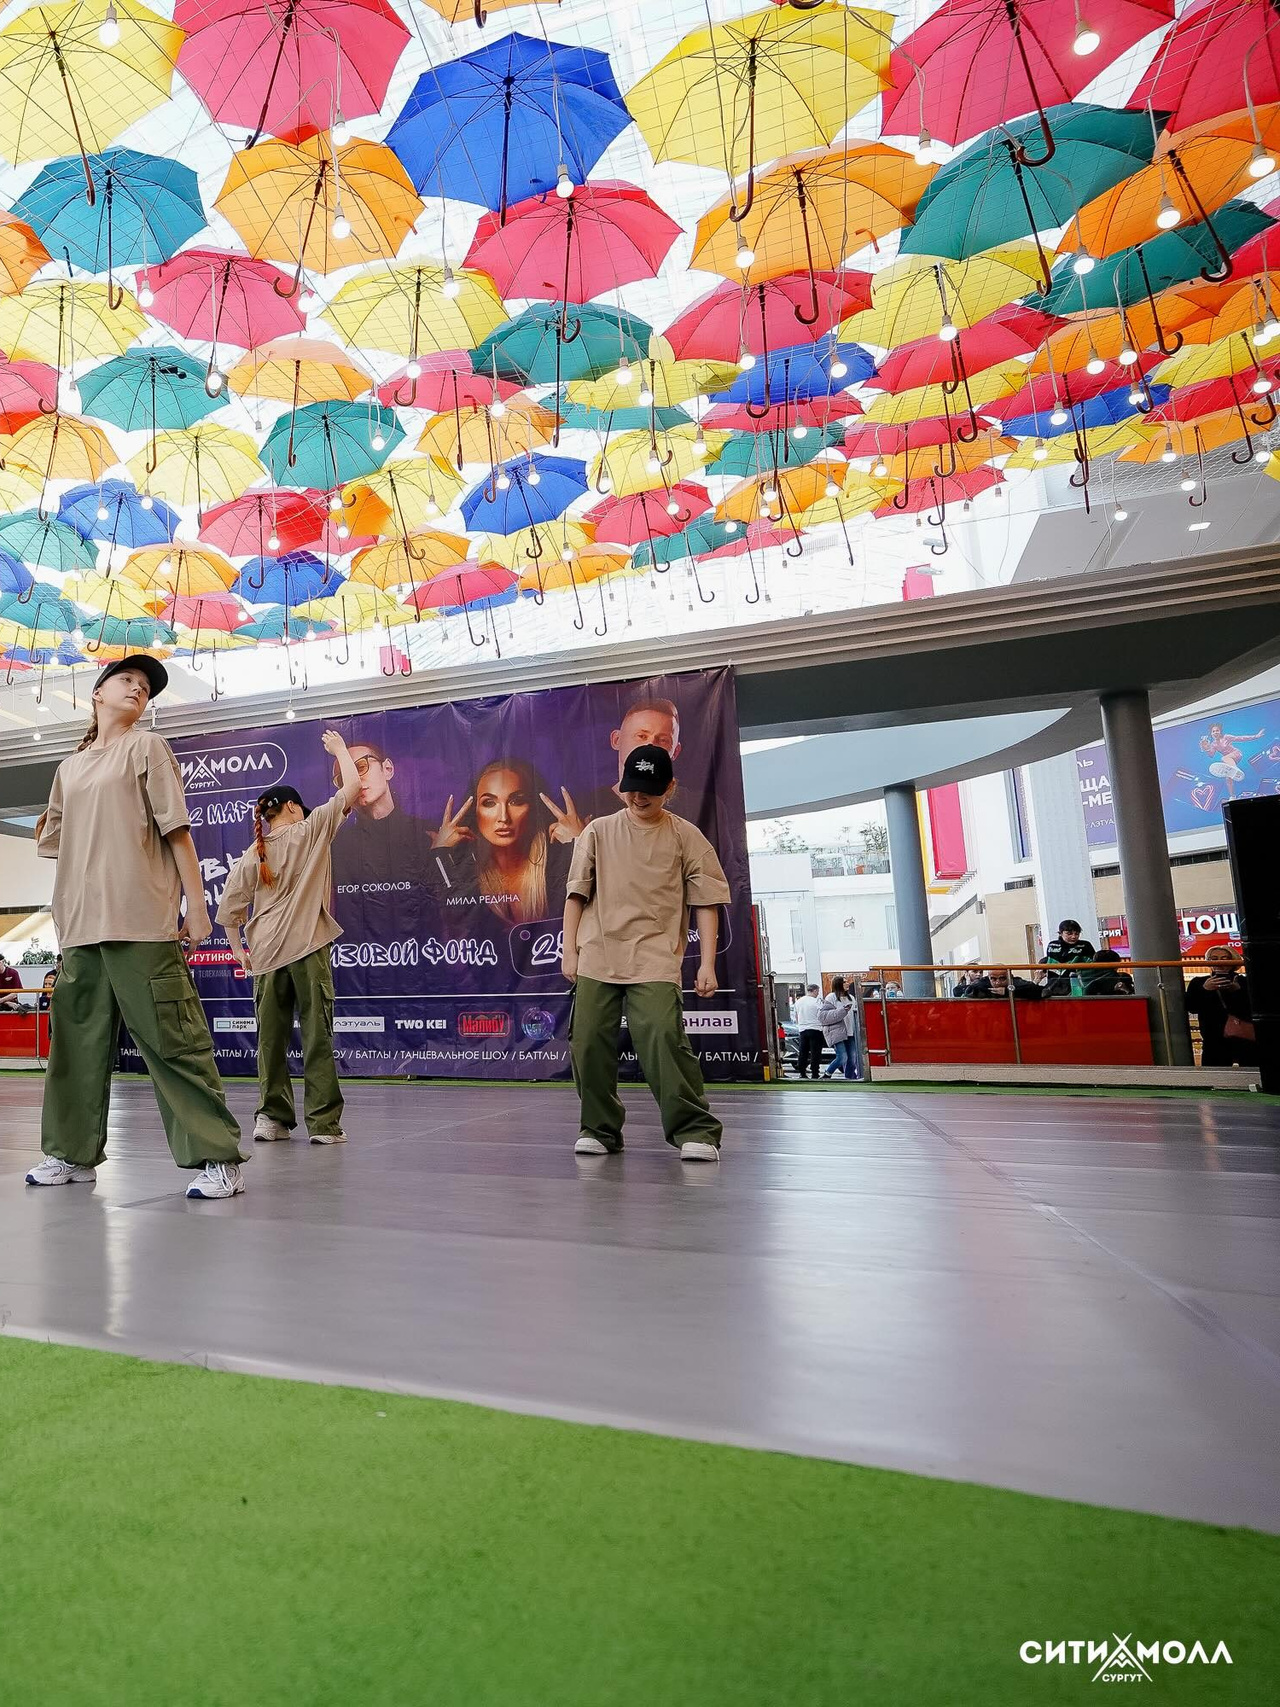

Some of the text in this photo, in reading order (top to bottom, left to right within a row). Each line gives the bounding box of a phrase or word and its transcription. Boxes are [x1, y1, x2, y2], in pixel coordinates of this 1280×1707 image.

[190, 780, 215, 789] СУРГУТ
[337, 881, 411, 894] ЕГОР СОКОЛОВ
[446, 894, 520, 906] МИЛА РЕДИНА
[331, 937, 498, 968] ИЗОВОЙ ФОНД
[395, 1019, 447, 1029] TWO KEI
[355, 1050, 391, 1059] БАТТЛЫ
[401, 1050, 479, 1061] ТАНЦЕВАЛЬНОЕ
[482, 1050, 507, 1060] ШОУ
[519, 1051, 559, 1061] БАТТЛЫ
[705, 1051, 750, 1062] БАТТЛЫ
